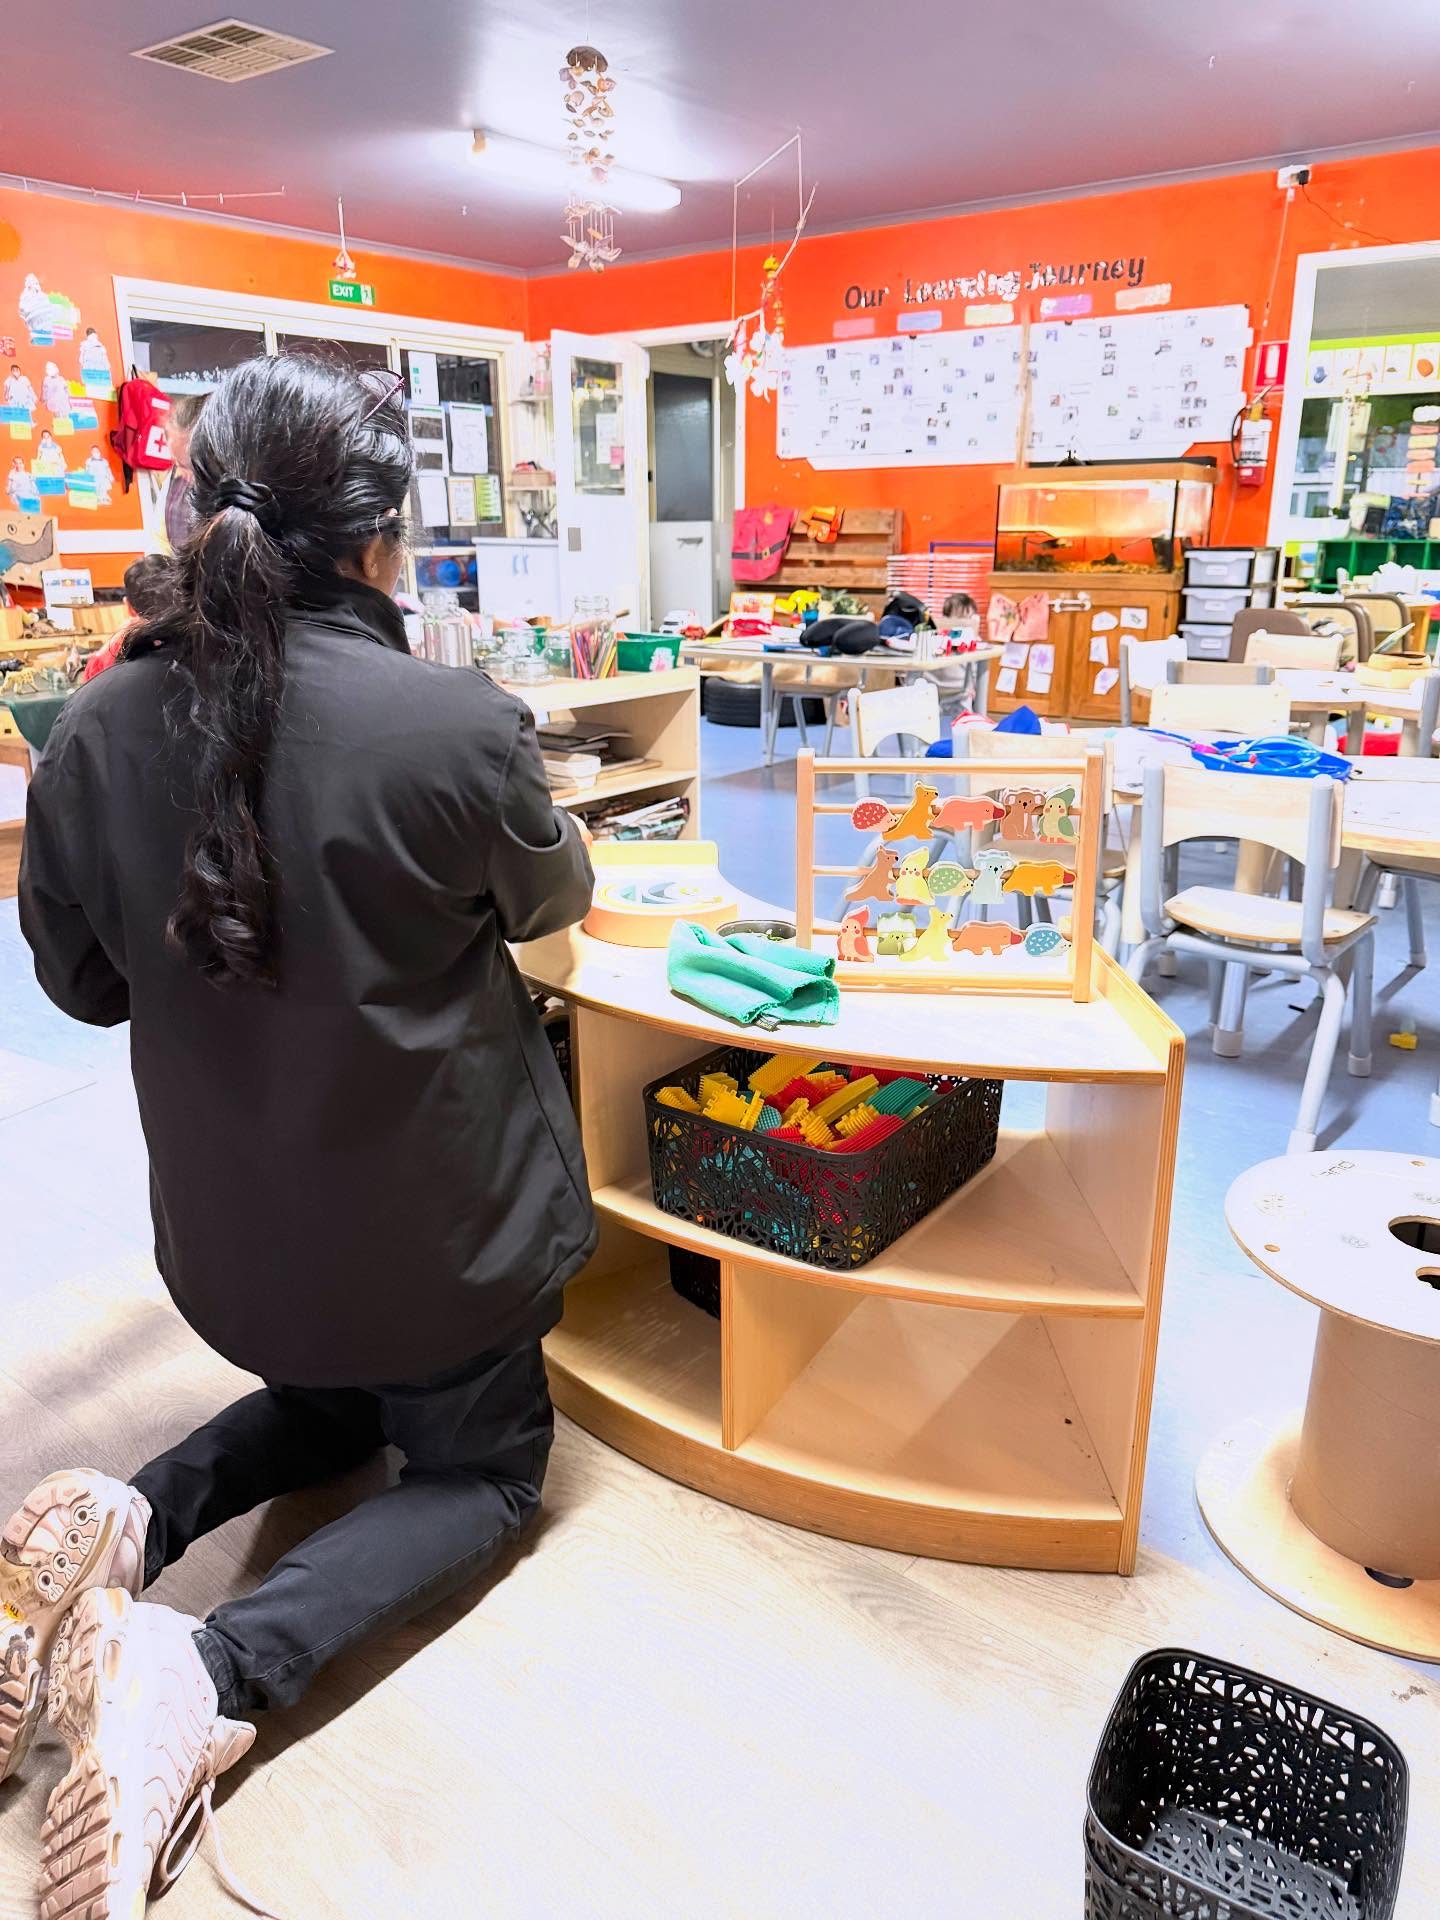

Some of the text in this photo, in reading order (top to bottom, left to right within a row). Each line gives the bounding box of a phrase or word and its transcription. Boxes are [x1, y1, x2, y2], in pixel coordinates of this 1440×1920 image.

[332, 284, 354, 298] EXIT
[845, 286, 890, 309] Our
[1024, 257, 1146, 290] Journey
